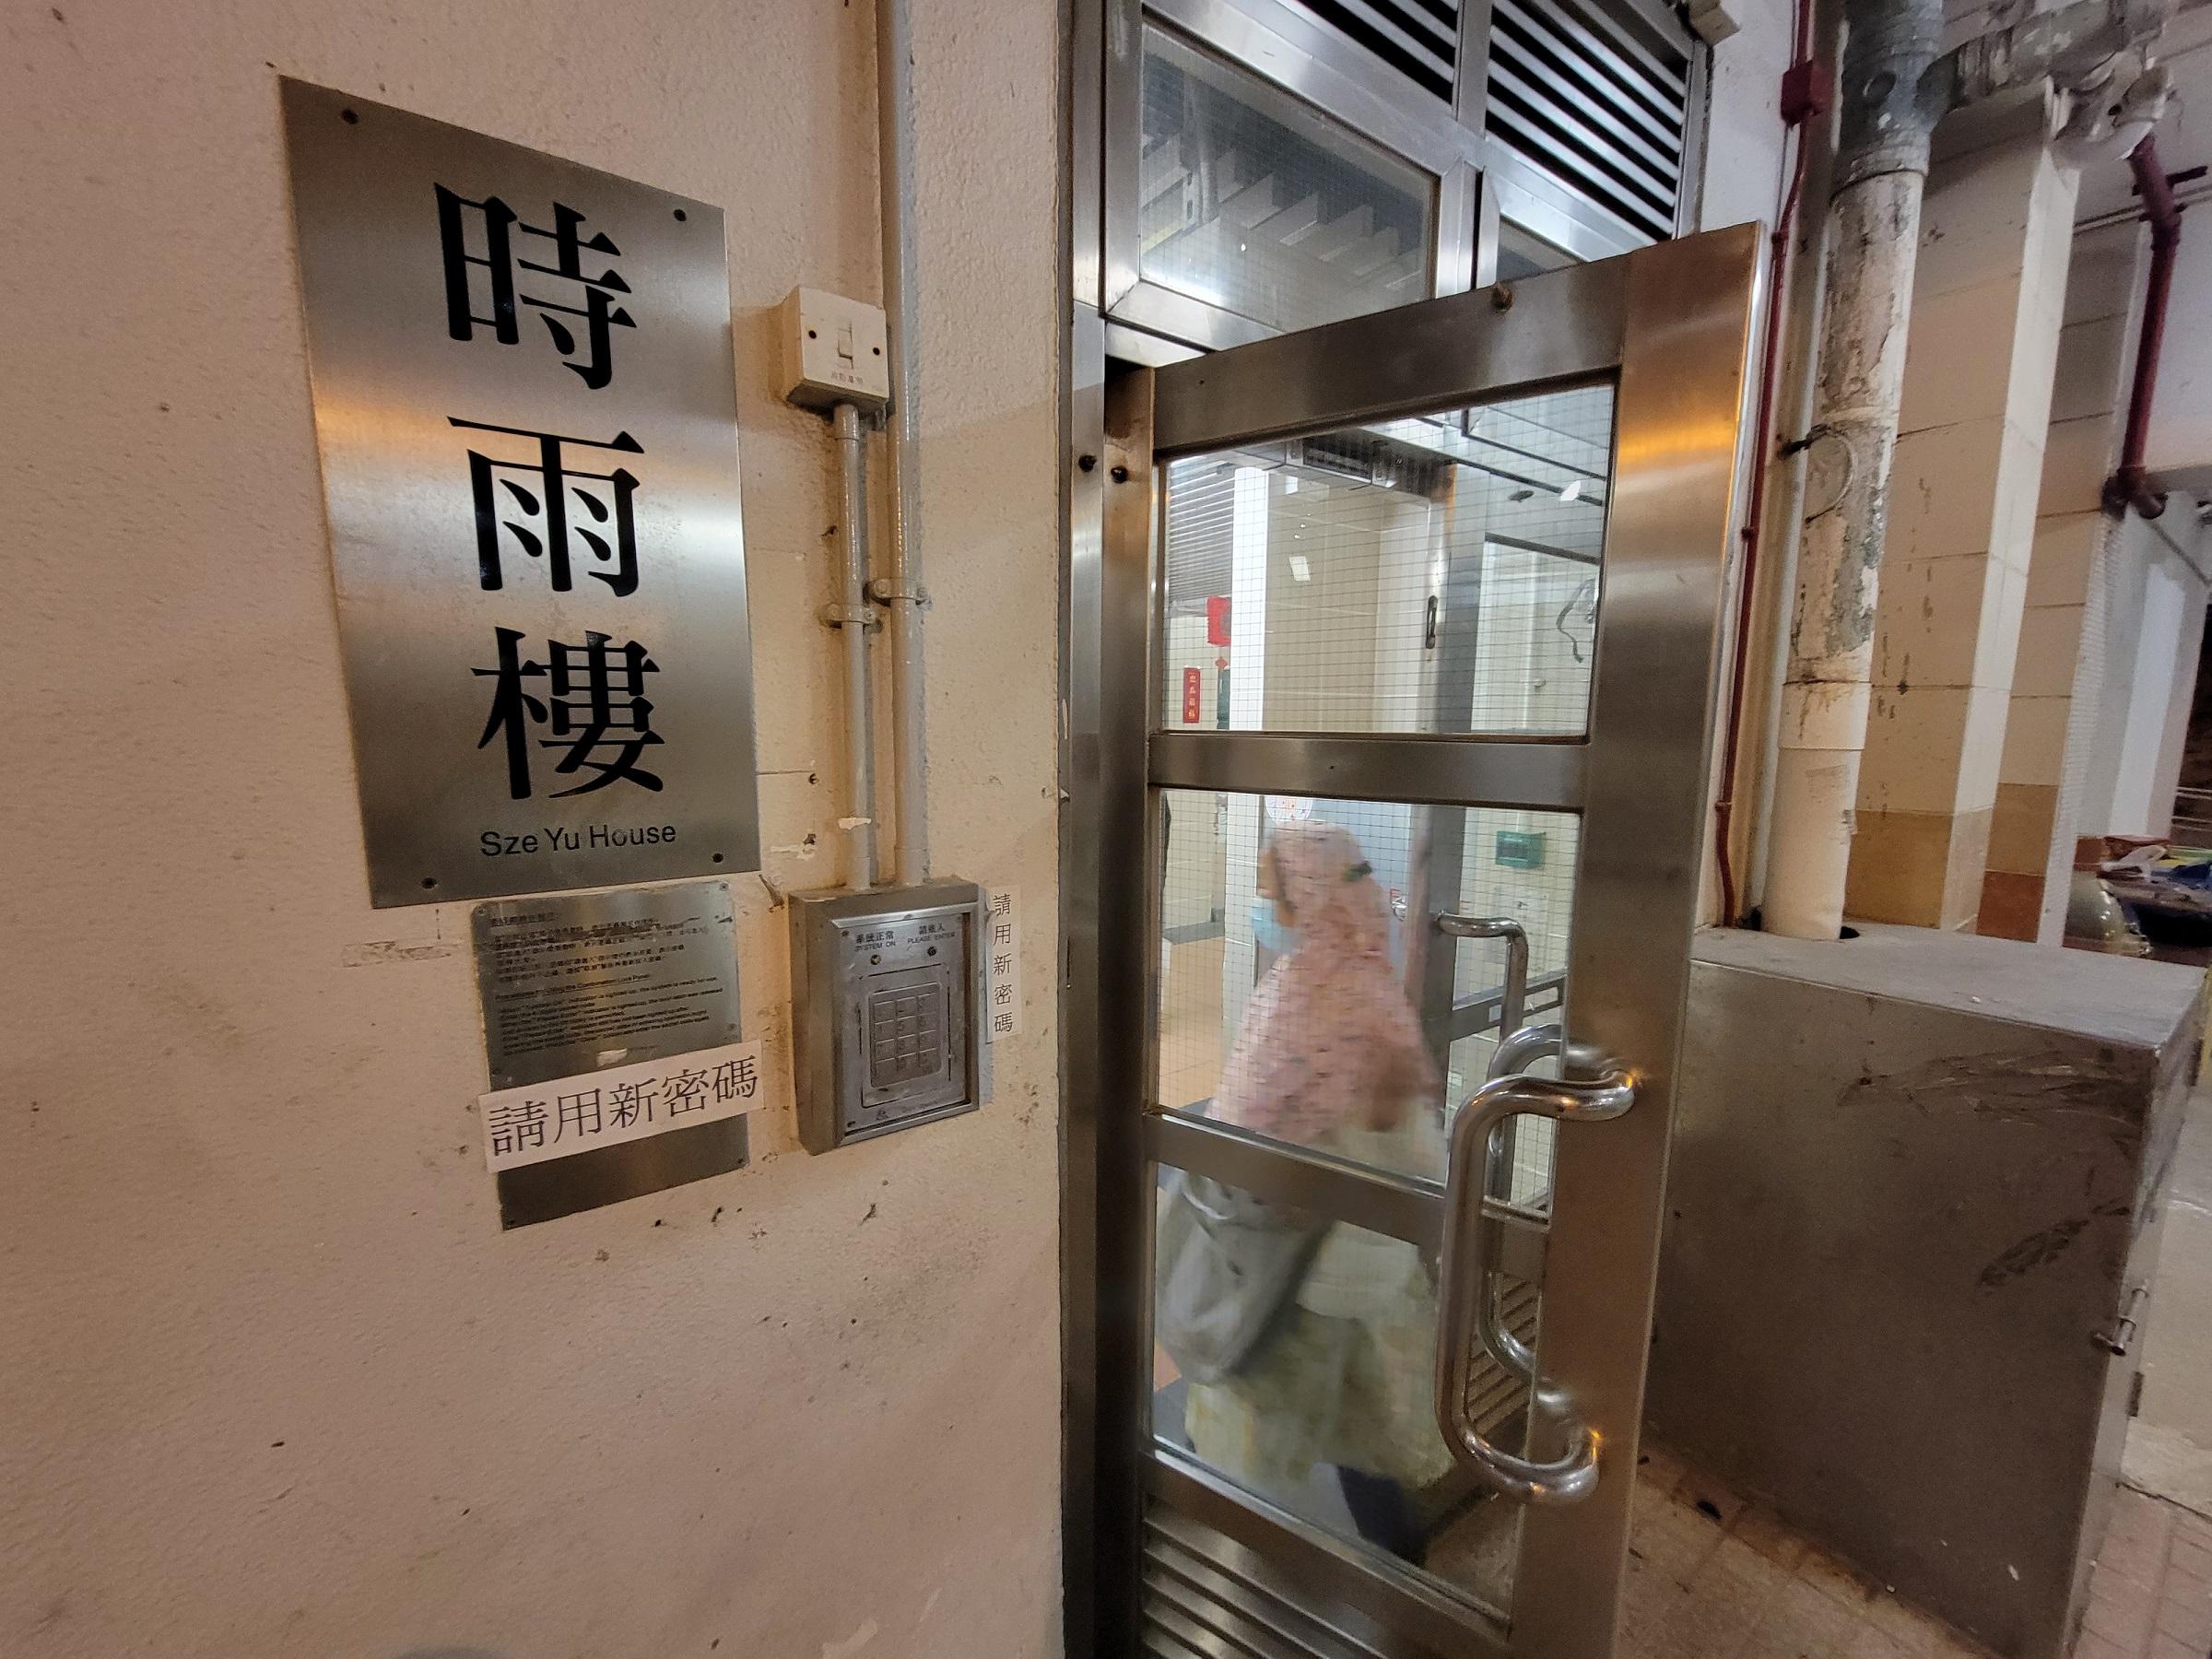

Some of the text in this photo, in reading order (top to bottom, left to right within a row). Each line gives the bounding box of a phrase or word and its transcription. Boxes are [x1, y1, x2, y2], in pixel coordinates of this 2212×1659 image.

[434, 182, 665, 800] 時雨樓
[480, 824, 677, 856] Sze Yu House
[854, 939, 896, 952] SYSTEM ON
[907, 935, 931, 944] PLEASE
[993, 893, 1013, 1033] 請用新密碼
[488, 1055, 759, 1156] 請用新密碼
